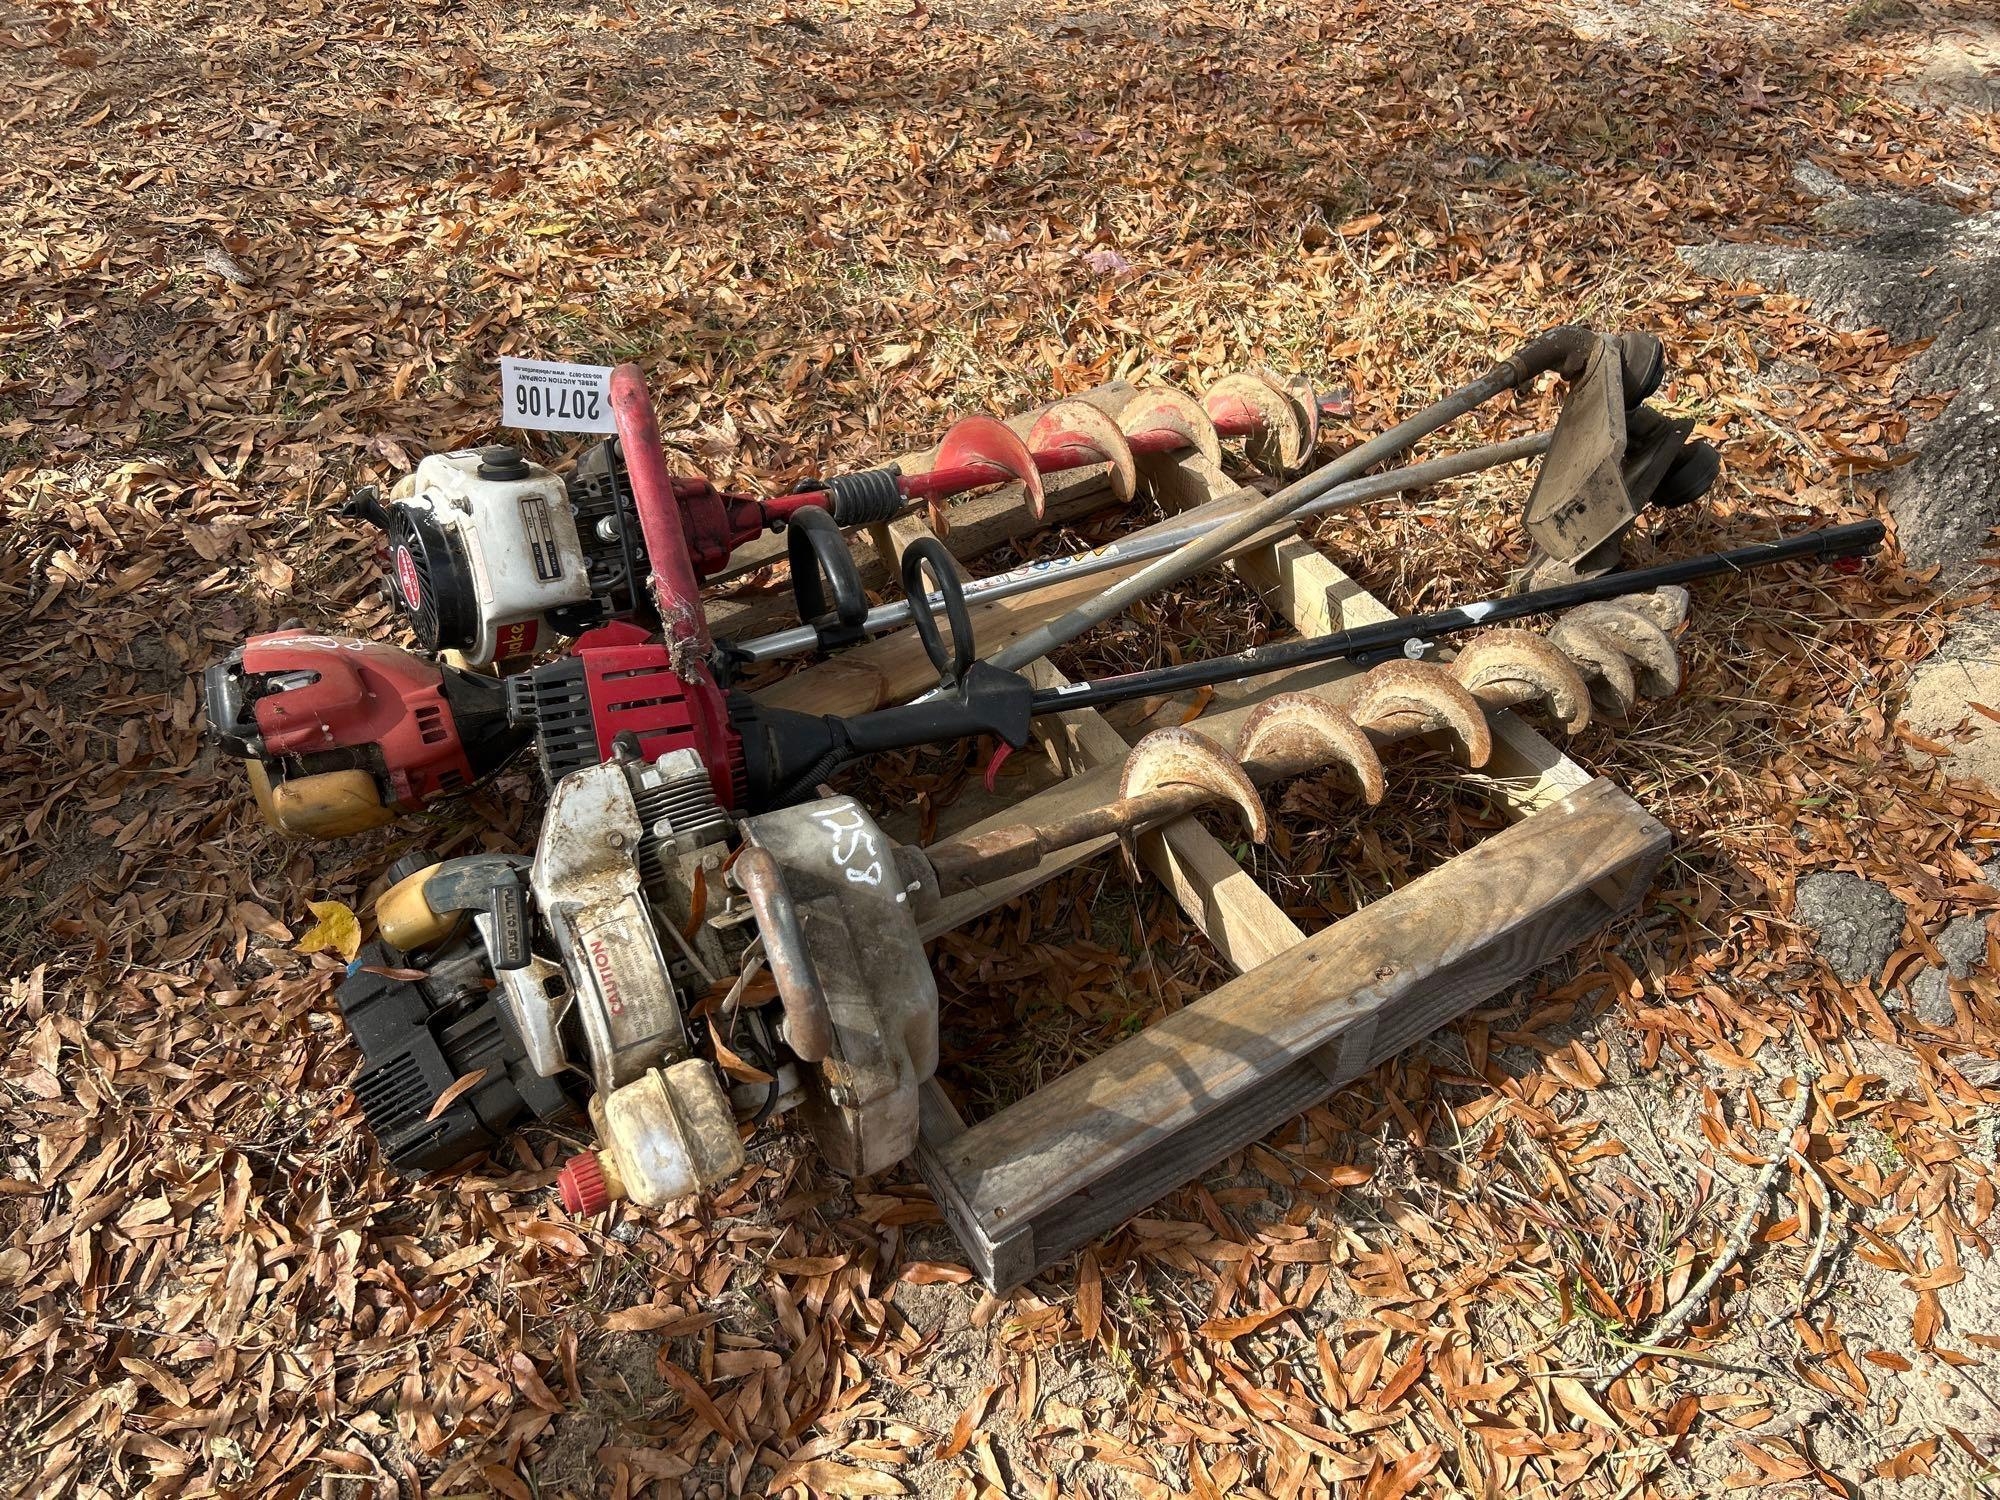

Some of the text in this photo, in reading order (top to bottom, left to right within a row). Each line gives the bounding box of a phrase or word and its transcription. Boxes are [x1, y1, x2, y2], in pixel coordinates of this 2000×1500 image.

[516, 384, 600, 420] 207106
[518, 374, 547, 383] COMPANY
[548, 376, 576, 385] AUCTION
[809, 802, 882, 887] 1258
[504, 888, 518, 960] PULL TO START
[590, 940, 626, 1016] CAUTION
